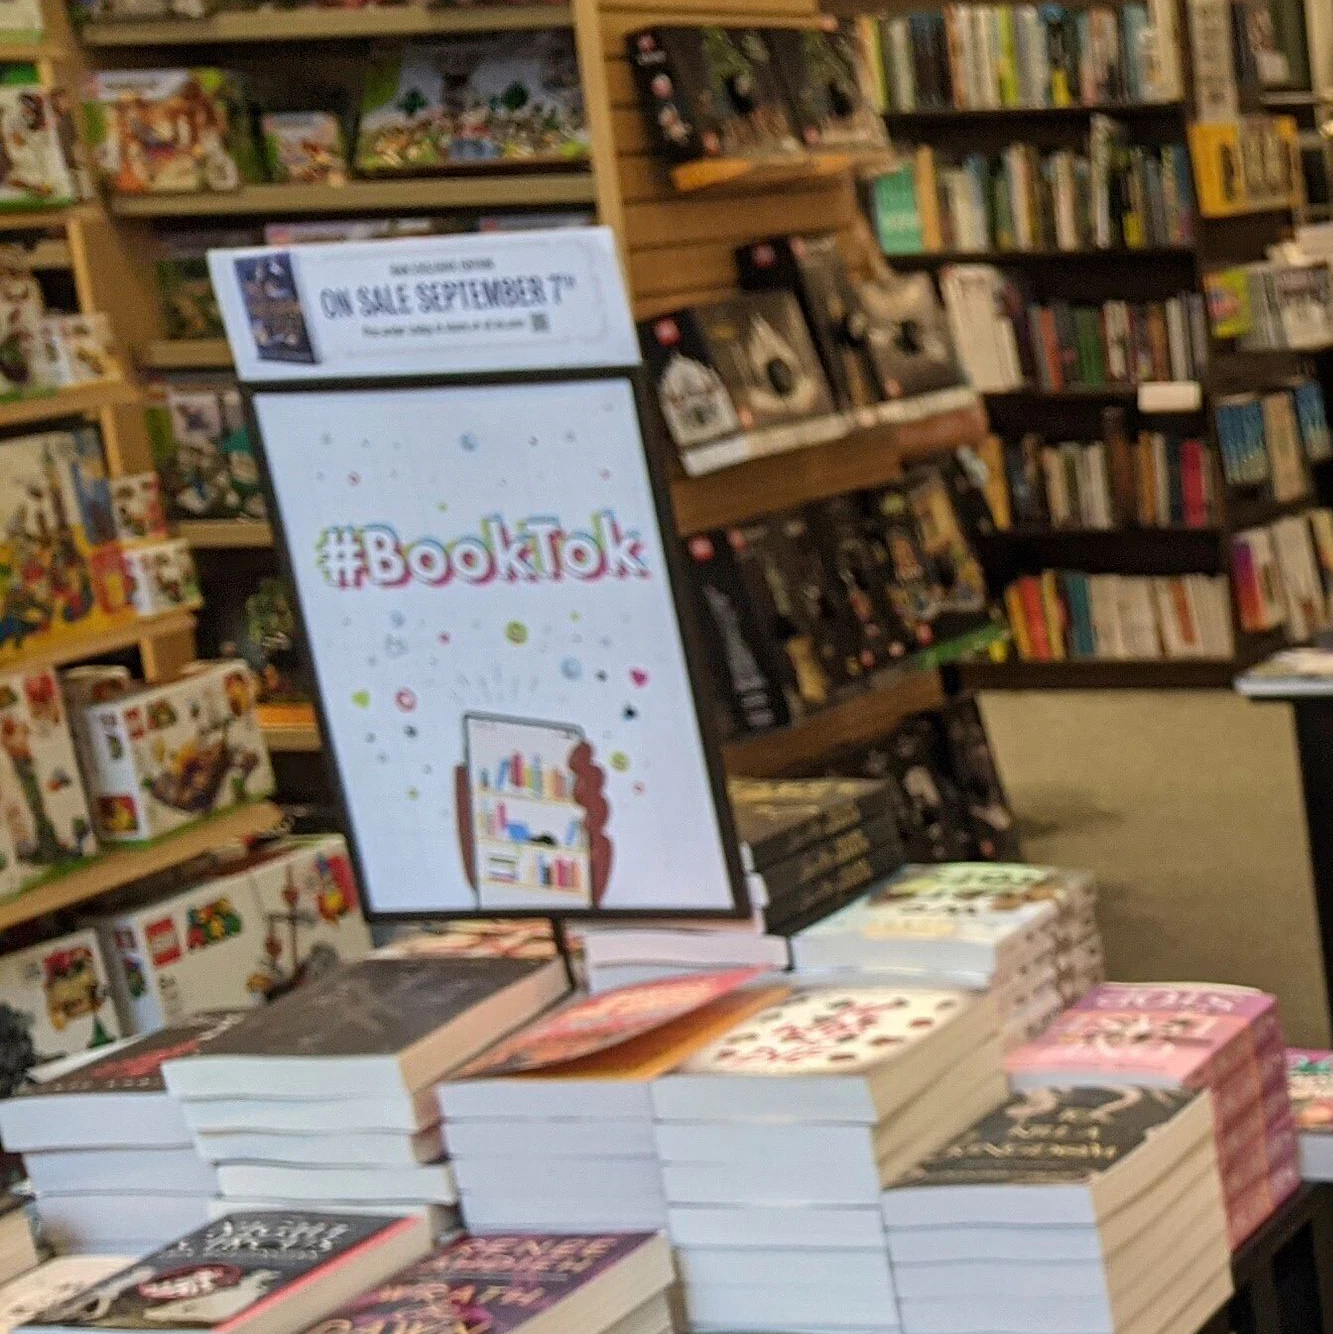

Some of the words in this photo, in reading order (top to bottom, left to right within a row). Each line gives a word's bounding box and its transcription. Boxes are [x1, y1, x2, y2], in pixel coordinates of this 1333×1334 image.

[320, 287, 350, 321] ON
[357, 284, 408, 318] SALE
[413, 274, 547, 314] SEPTEMBER
[314, 510, 653, 589] #BookTok
